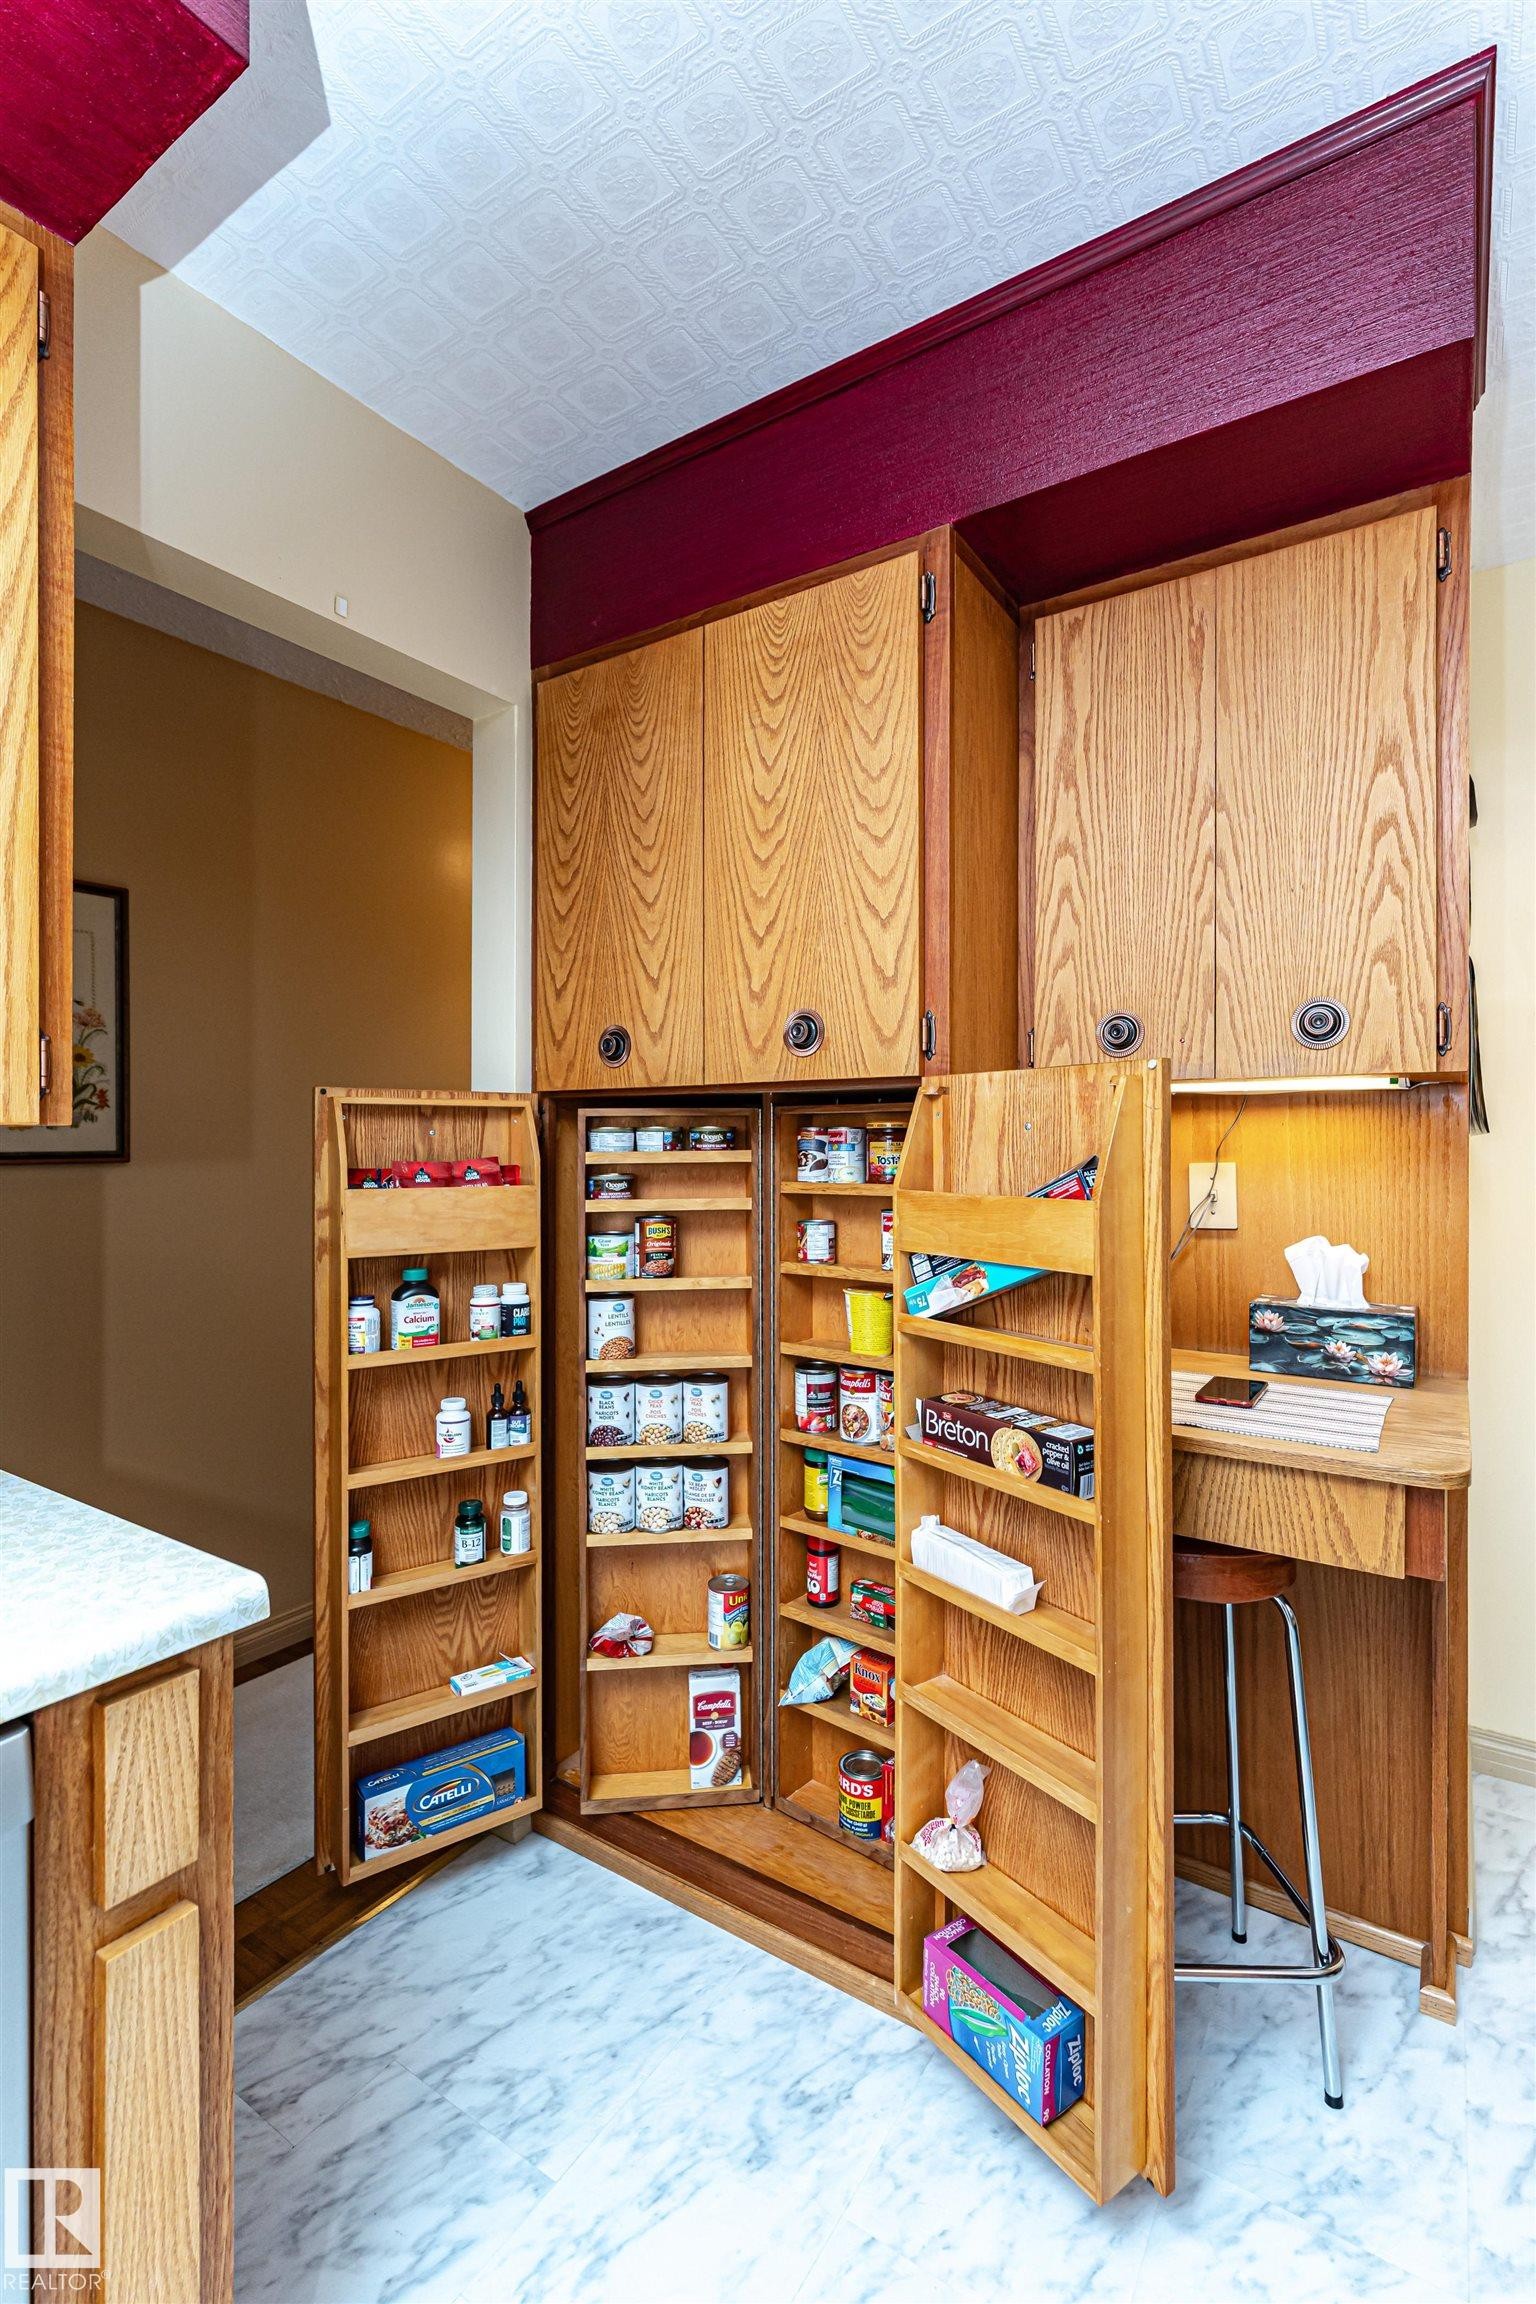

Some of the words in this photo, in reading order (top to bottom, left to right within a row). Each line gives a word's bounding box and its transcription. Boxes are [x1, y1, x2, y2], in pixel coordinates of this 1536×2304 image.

[701, 1133, 723, 1143] Ocean's
[648, 1227, 671, 1236] BUSH'S
[403, 1315, 435, 1324] Calcium
[926, 1409, 989, 1452] Breton
[1042, 1448, 1063, 1459] pepper
[1045, 1442, 1069, 1454] cracked
[1046, 1458, 1061, 1467] olive
[1061, 1462, 1069, 1470] oil
[462, 1538, 481, 1548] B-12
[855, 1663, 880, 1683] Knox
[367, 1773, 400, 1786] CATELLI
[420, 1783, 472, 1810] CATELLI
[933, 1918, 966, 1941] COLLATION
[944, 1926, 965, 1940] SNACK
[1042, 2000, 1072, 2033] Ziploc
[1009, 2023, 1032, 2106] Ziploc
[1067, 2034, 1083, 2087] Ziploc
[1043, 2044, 1051, 2095] COLLATION
